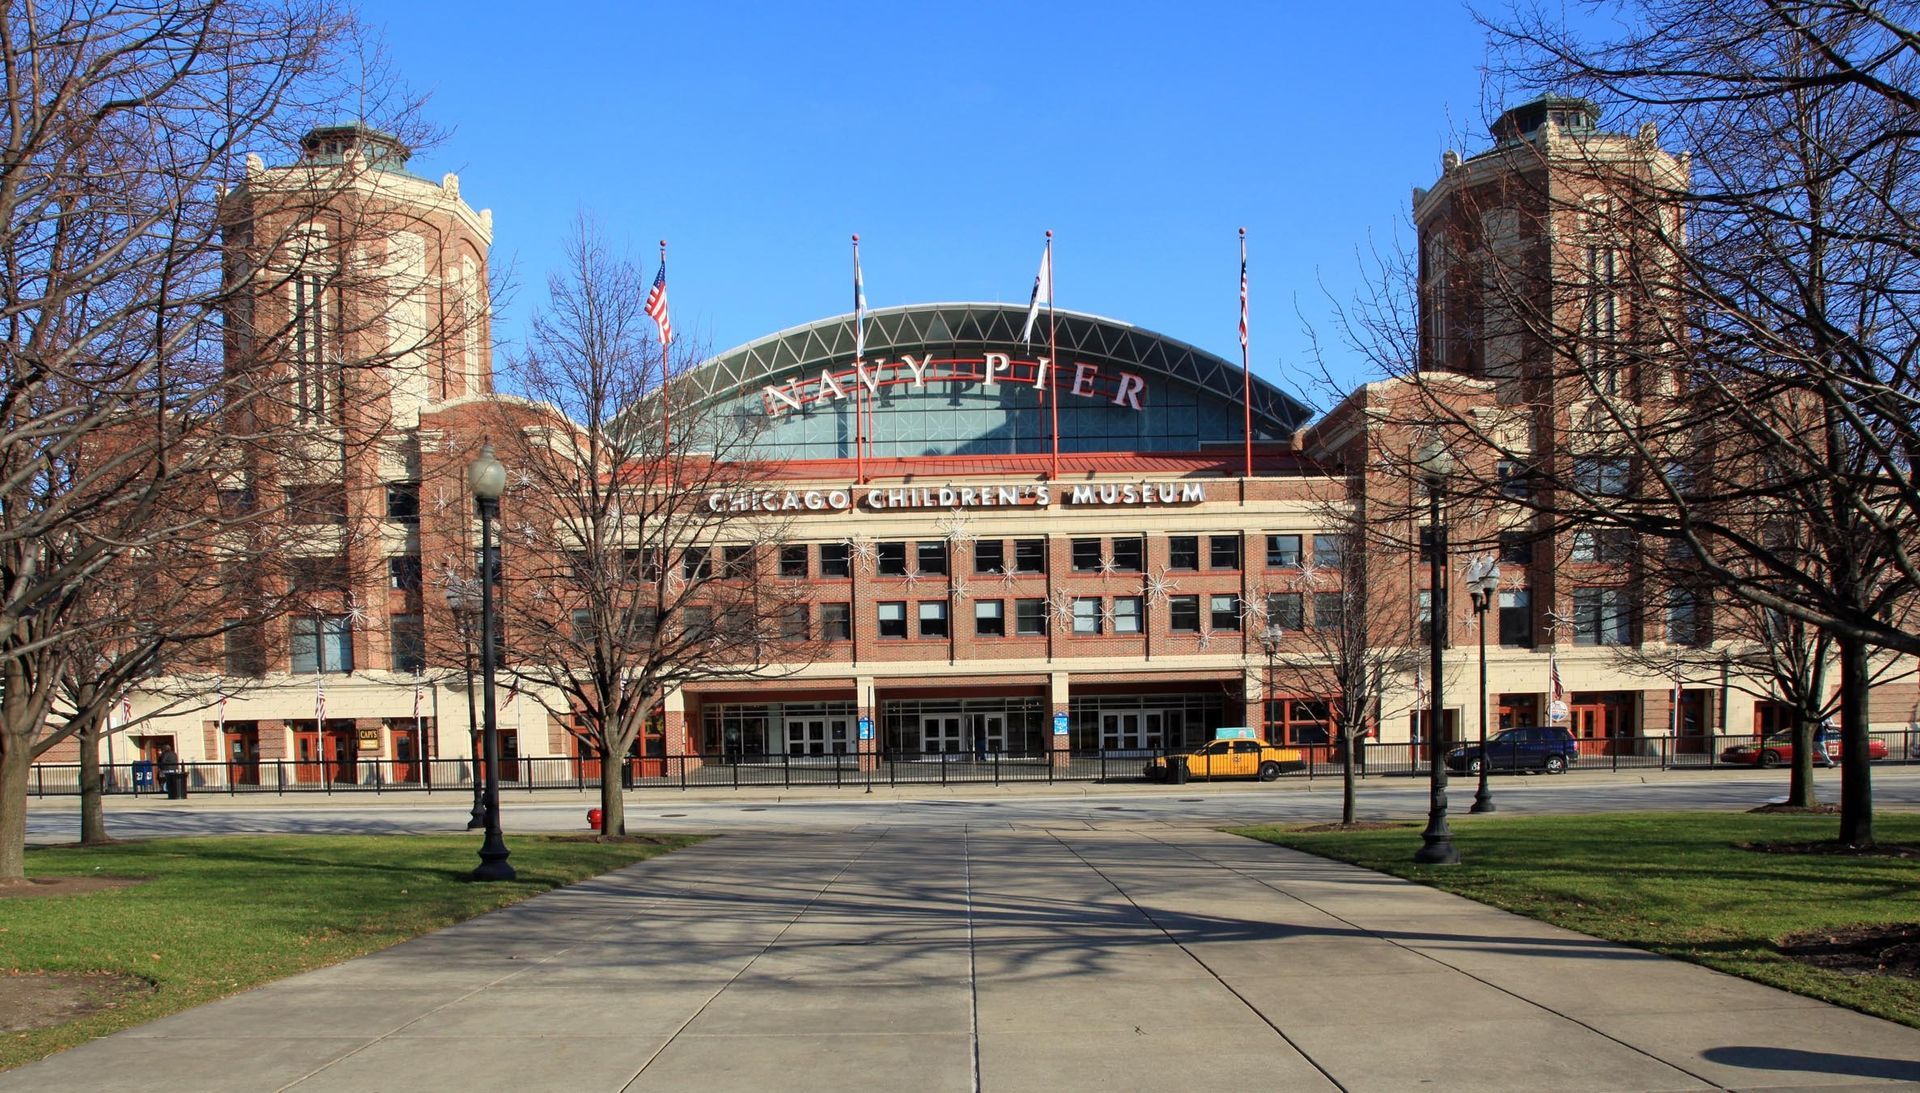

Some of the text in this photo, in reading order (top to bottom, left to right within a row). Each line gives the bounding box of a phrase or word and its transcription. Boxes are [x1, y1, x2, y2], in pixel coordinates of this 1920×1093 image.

[763, 352, 1146, 417] NAVY PIER
[708, 481, 1206, 512] CHICAGO CHILDREN'S MUSEUM
